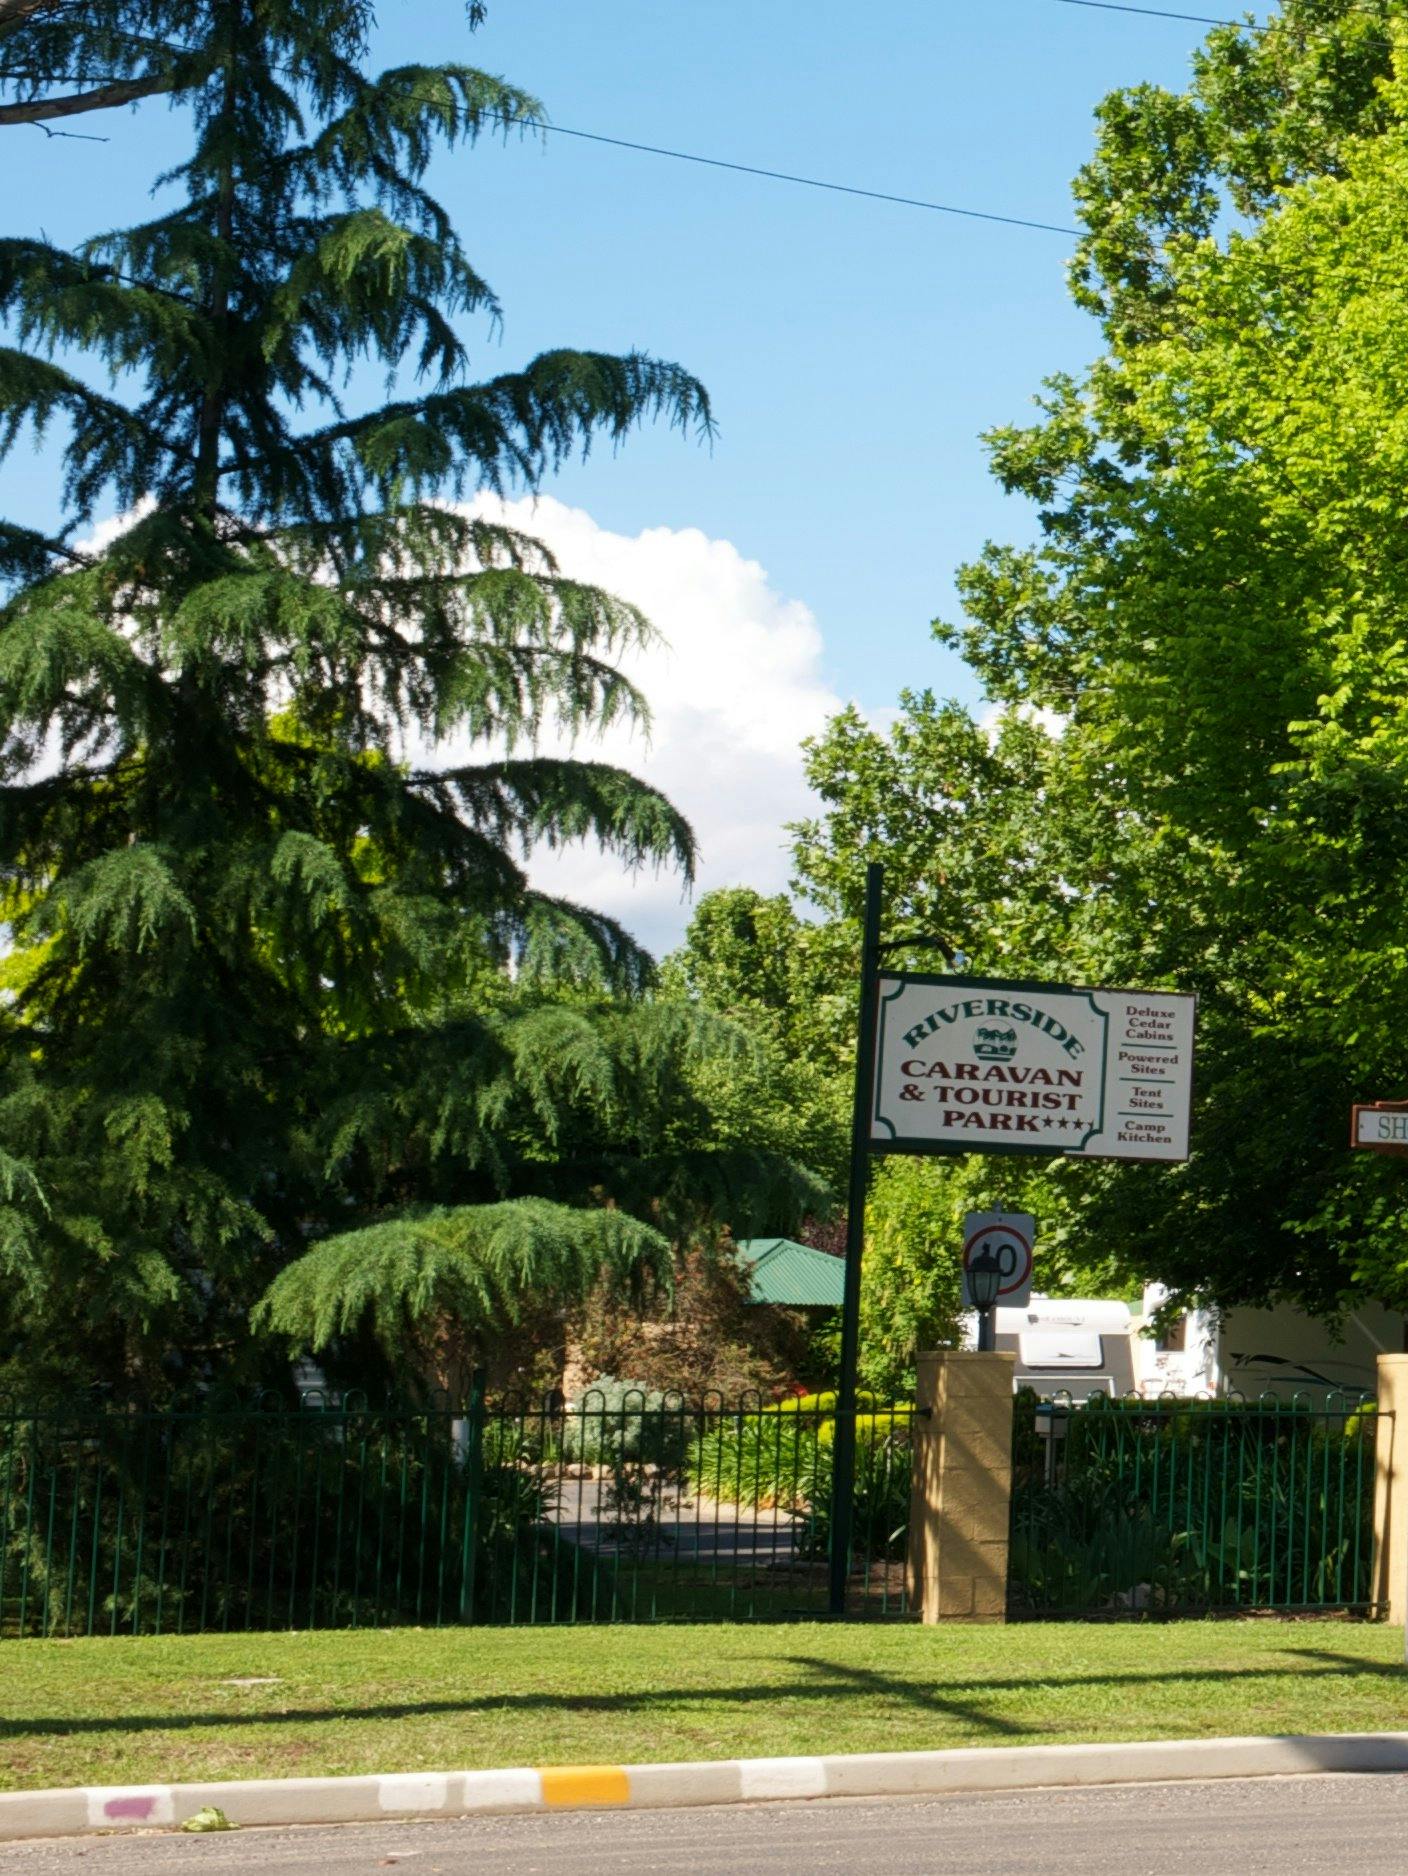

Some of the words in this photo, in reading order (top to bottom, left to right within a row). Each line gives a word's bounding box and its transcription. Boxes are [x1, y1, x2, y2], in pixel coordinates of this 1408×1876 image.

[1125, 1005, 1176, 1019] Deluxe
[902, 998, 1085, 1060] RIVERSIDE
[1128, 1017, 1171, 1030] Cedar
[1125, 1029, 1174, 1041] Cabins
[1118, 1051, 1179, 1065] Powered
[900, 1059, 1084, 1088] CARAVAN
[1130, 1063, 1166, 1075] Sites
[898, 1083, 926, 1102] &
[933, 1085, 1083, 1111] TOURIST
[1132, 1086, 1162, 1098] Tent
[1128, 1098, 1164, 1109] Sites
[942, 1109, 1040, 1132] PARK
[1124, 1120, 1166, 1134] Camp
[1117, 1131, 1172, 1144] Kitchen
